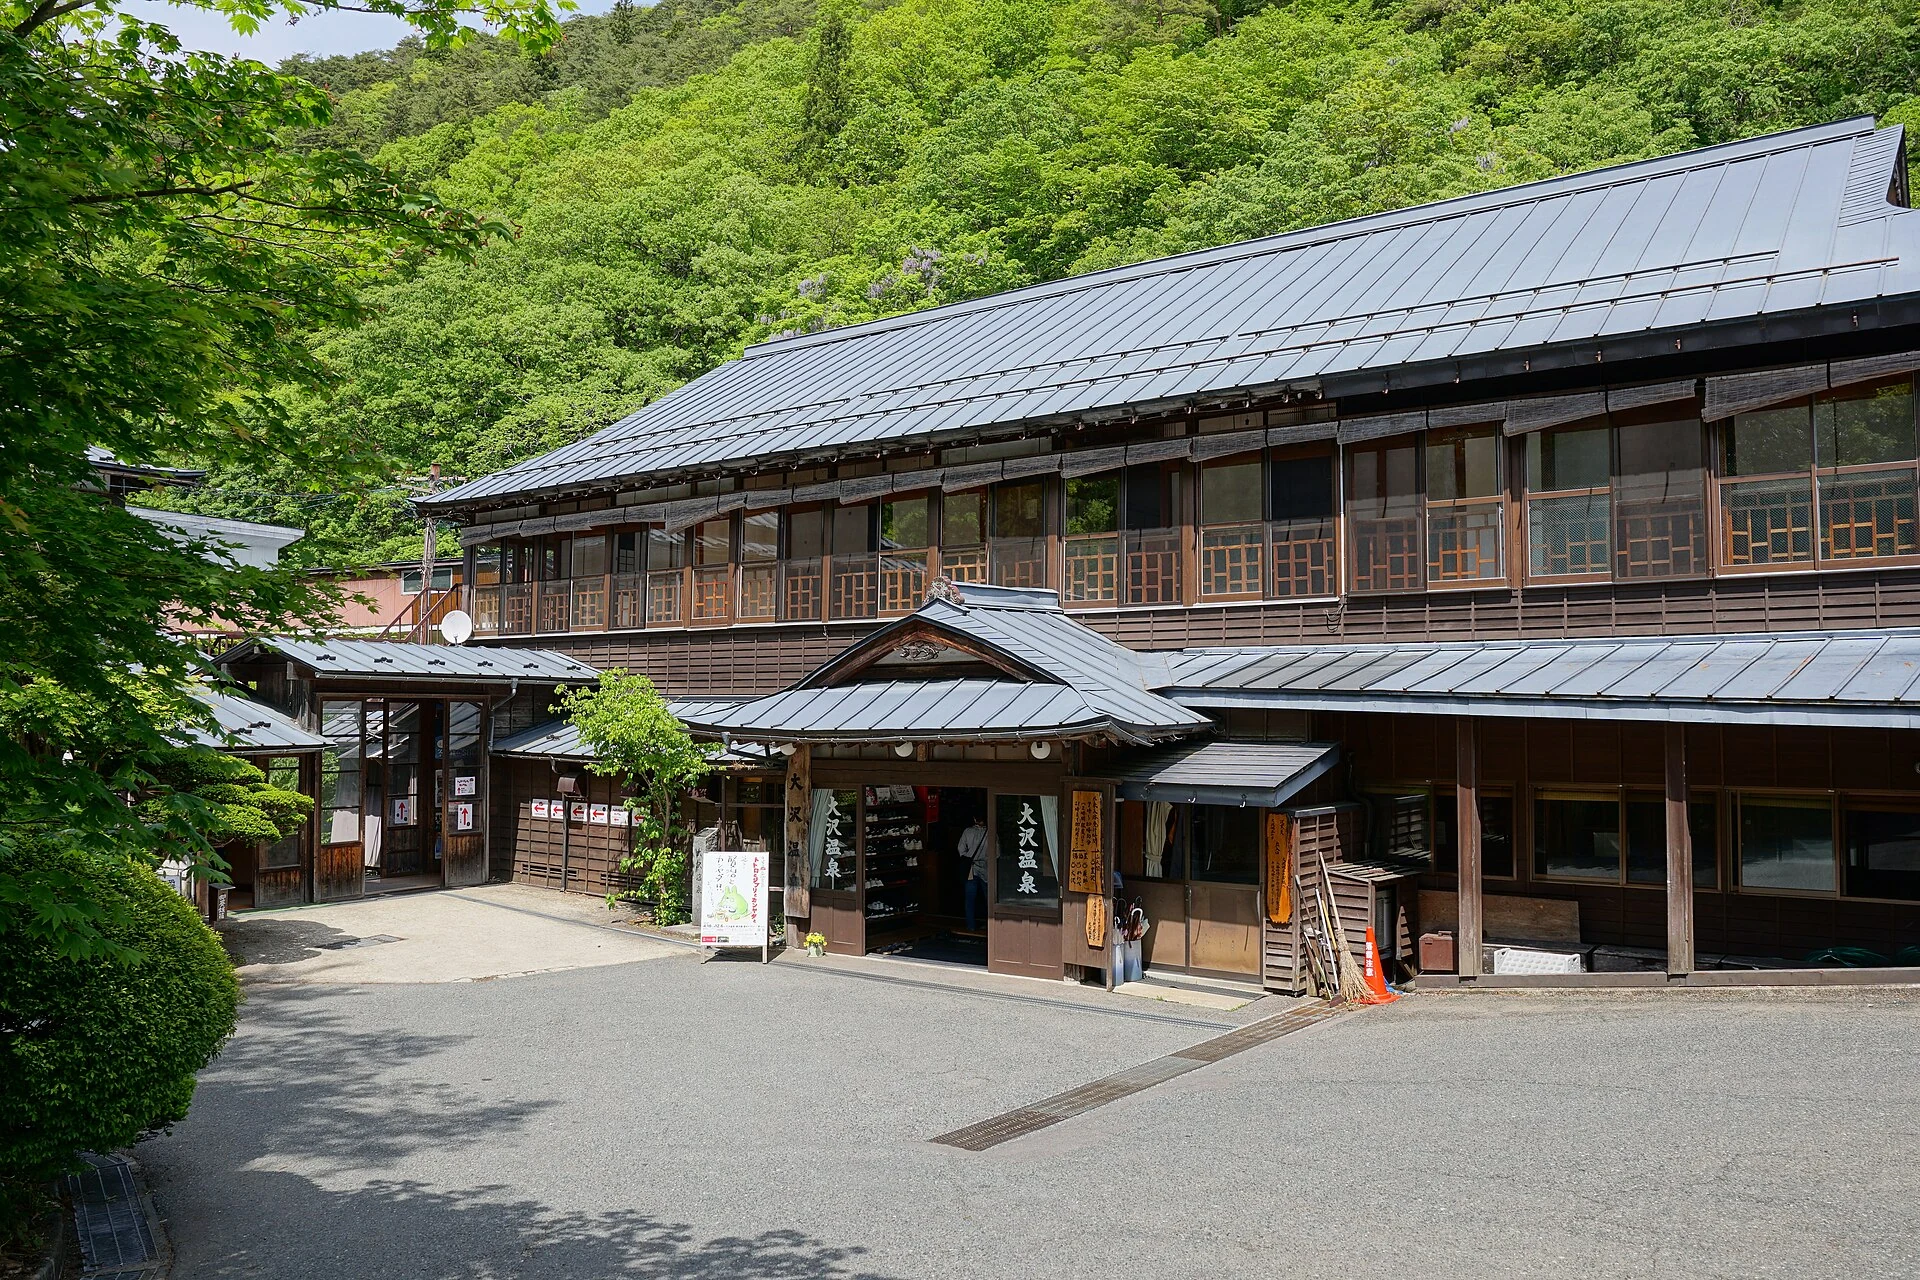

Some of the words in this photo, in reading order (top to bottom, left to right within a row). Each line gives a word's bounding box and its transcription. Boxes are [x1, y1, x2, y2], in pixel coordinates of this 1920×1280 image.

[824, 796, 842, 878] 大沢温泉
[1016, 802, 1039, 894] 大沢温泉
